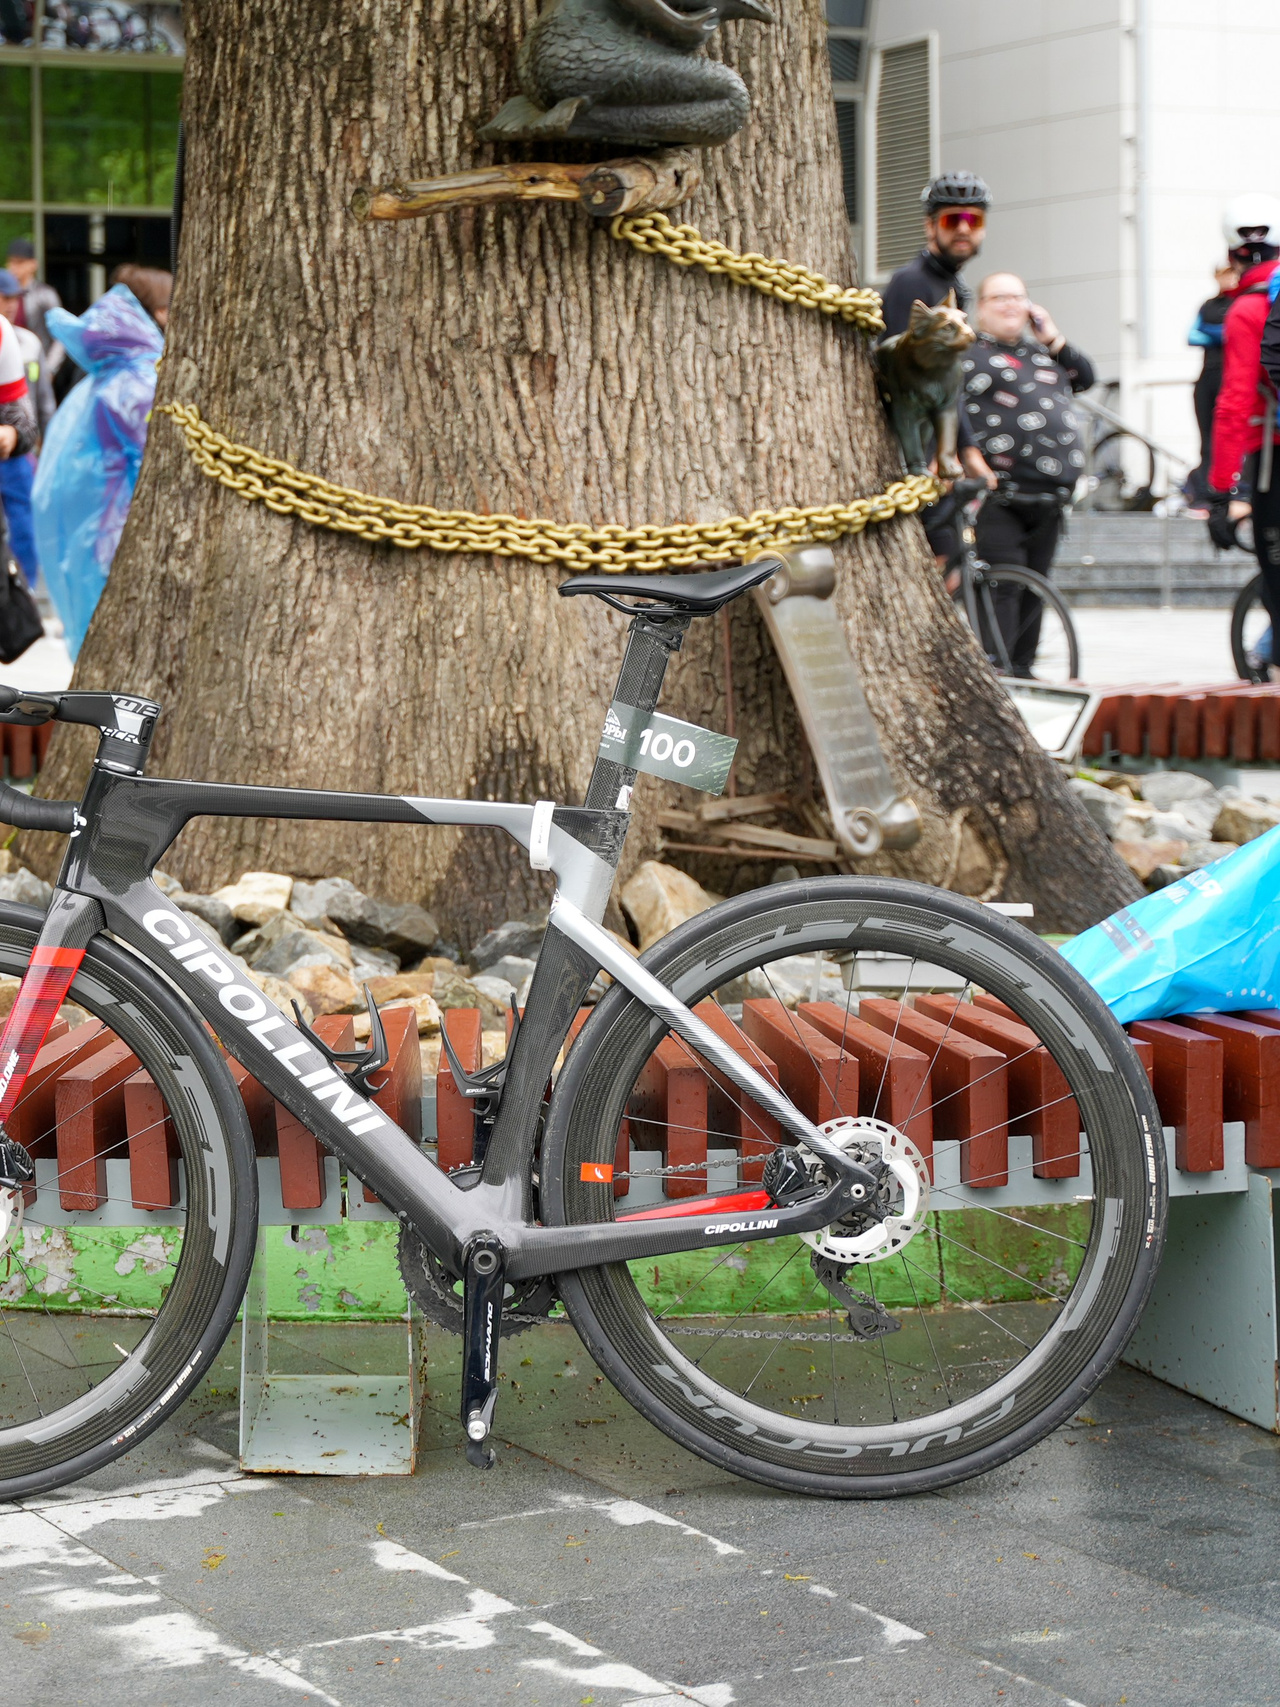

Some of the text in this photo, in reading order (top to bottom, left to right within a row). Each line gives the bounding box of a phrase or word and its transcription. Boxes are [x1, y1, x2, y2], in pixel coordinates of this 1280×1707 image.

[640, 728, 696, 768] 100
[143, 909, 387, 1136] CIPOLLINI
[704, 1219, 778, 1234] CIPOLLINI
[652, 1364, 1015, 1458] FULCRUM
